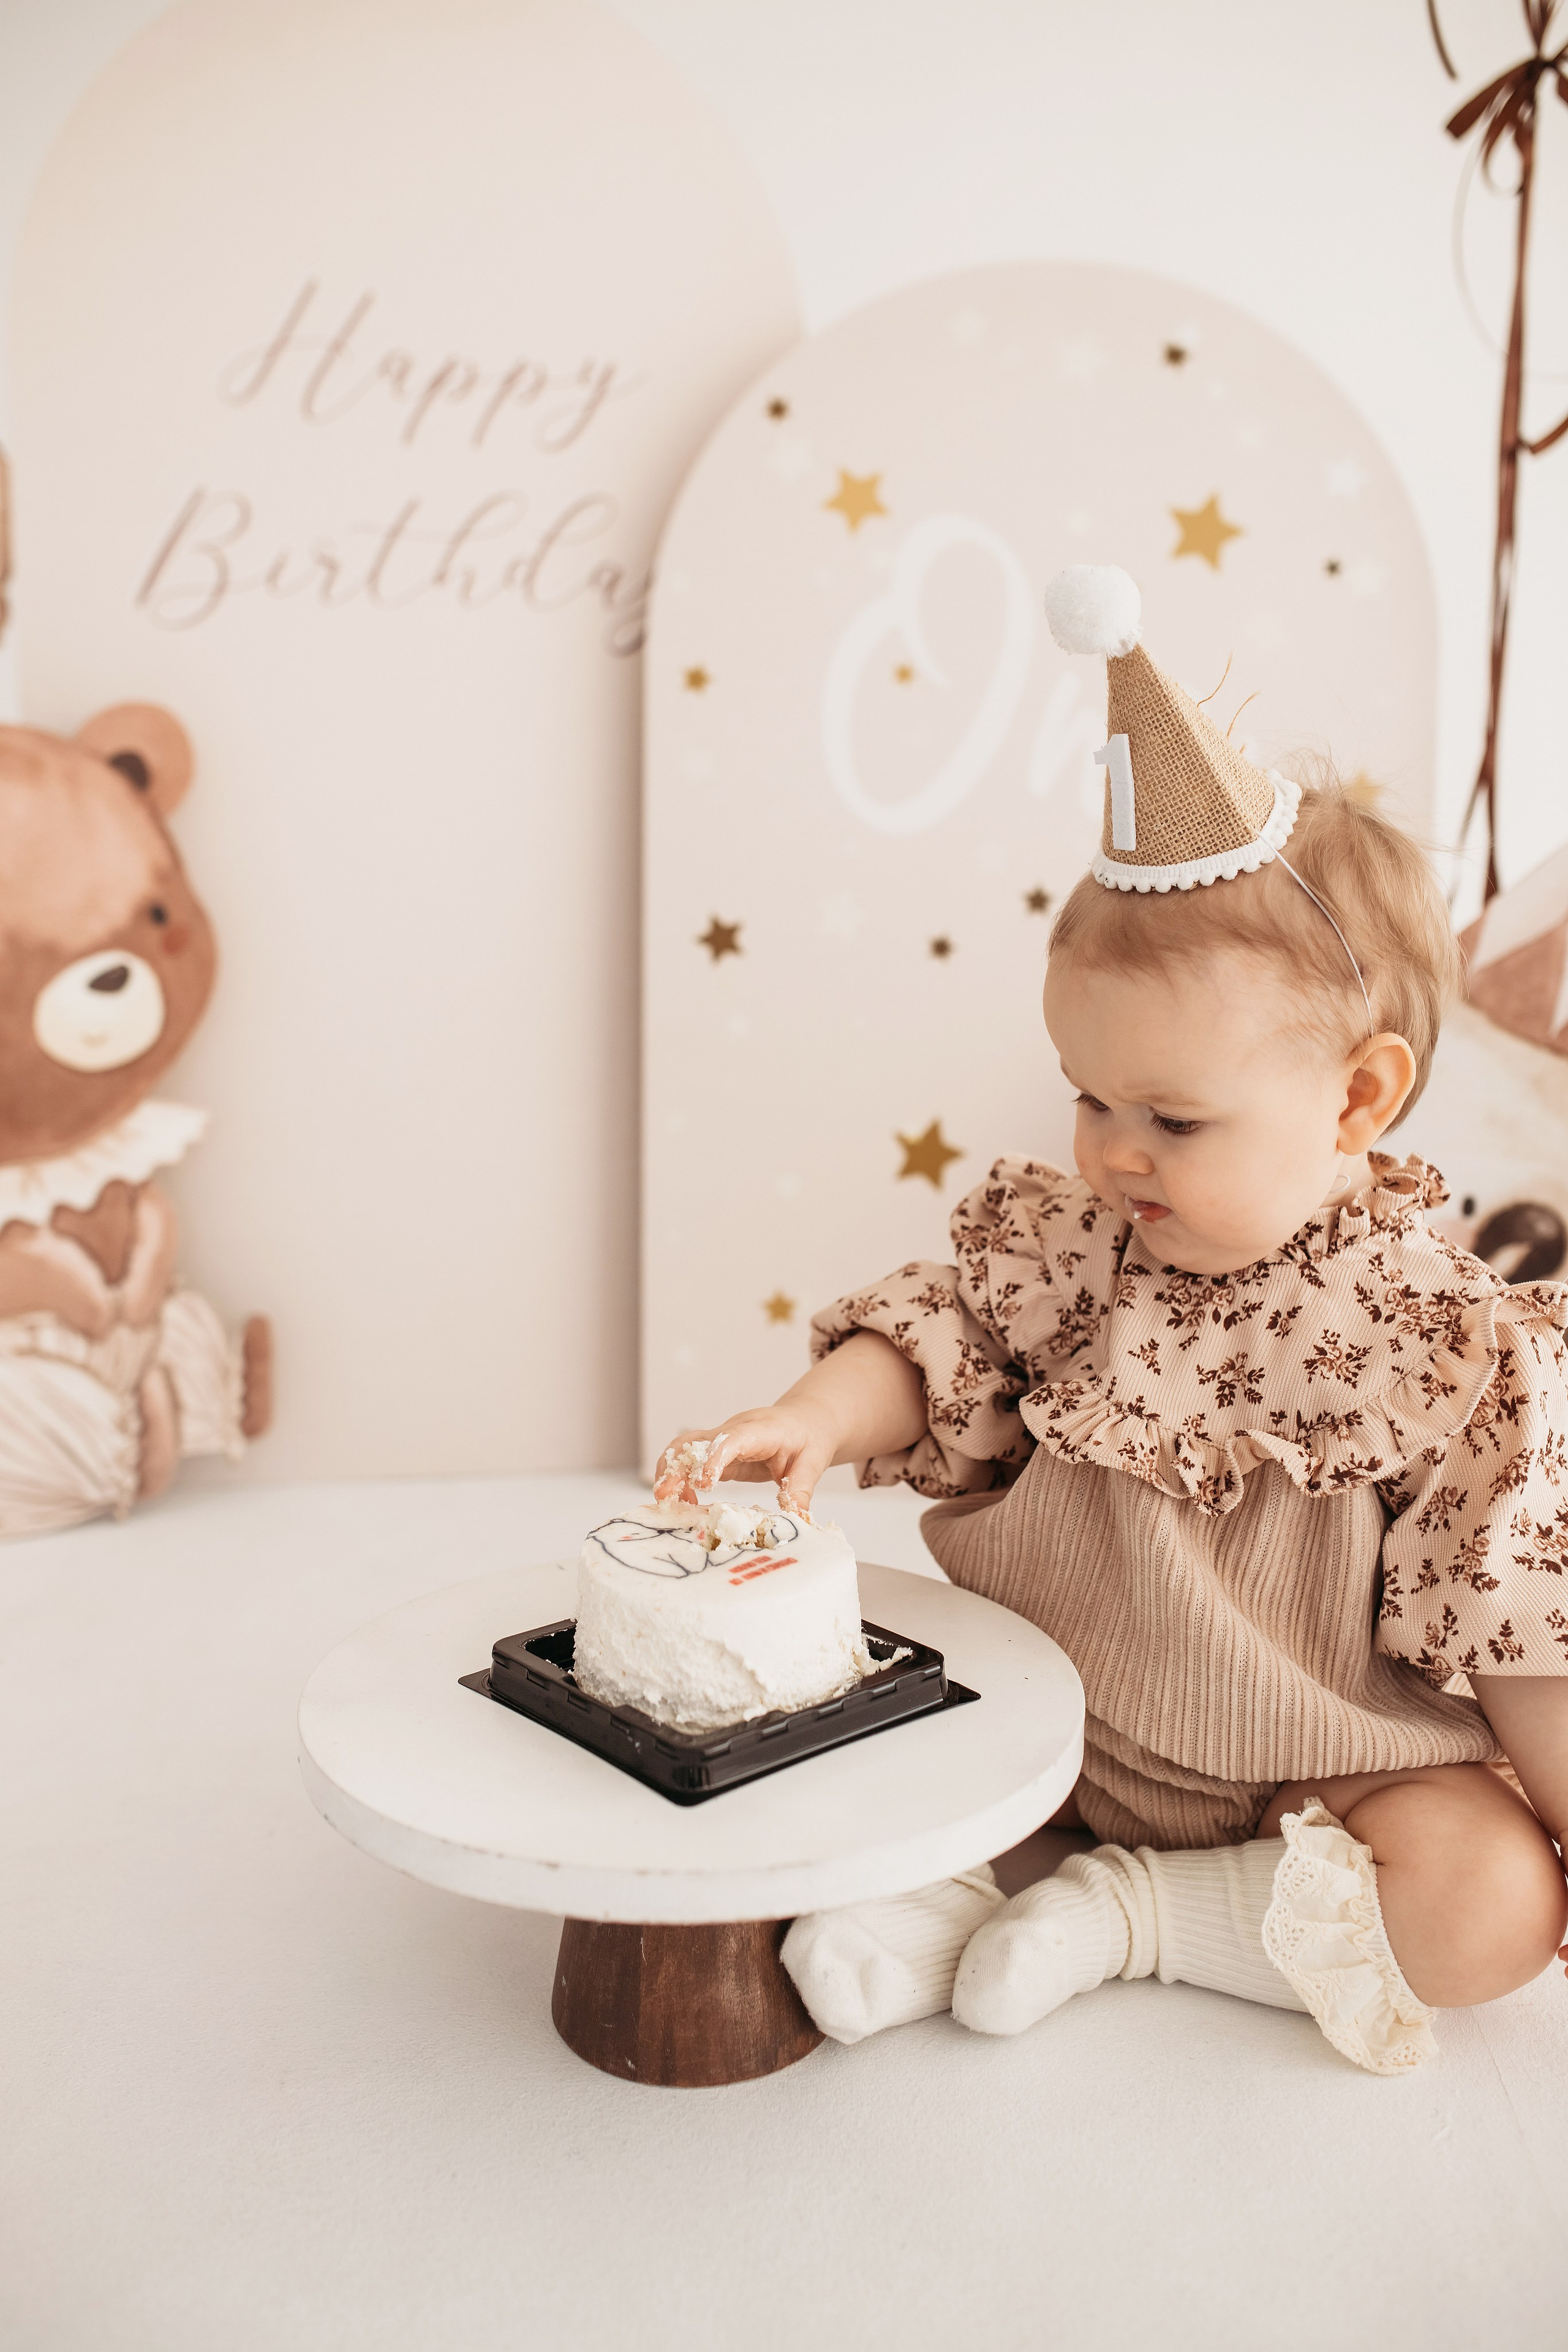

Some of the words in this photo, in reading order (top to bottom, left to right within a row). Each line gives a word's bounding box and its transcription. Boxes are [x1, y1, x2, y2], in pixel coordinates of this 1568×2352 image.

[217, 277, 647, 454] Happy
[821, 513, 1105, 834] On
[1093, 733, 1136, 851] 1
